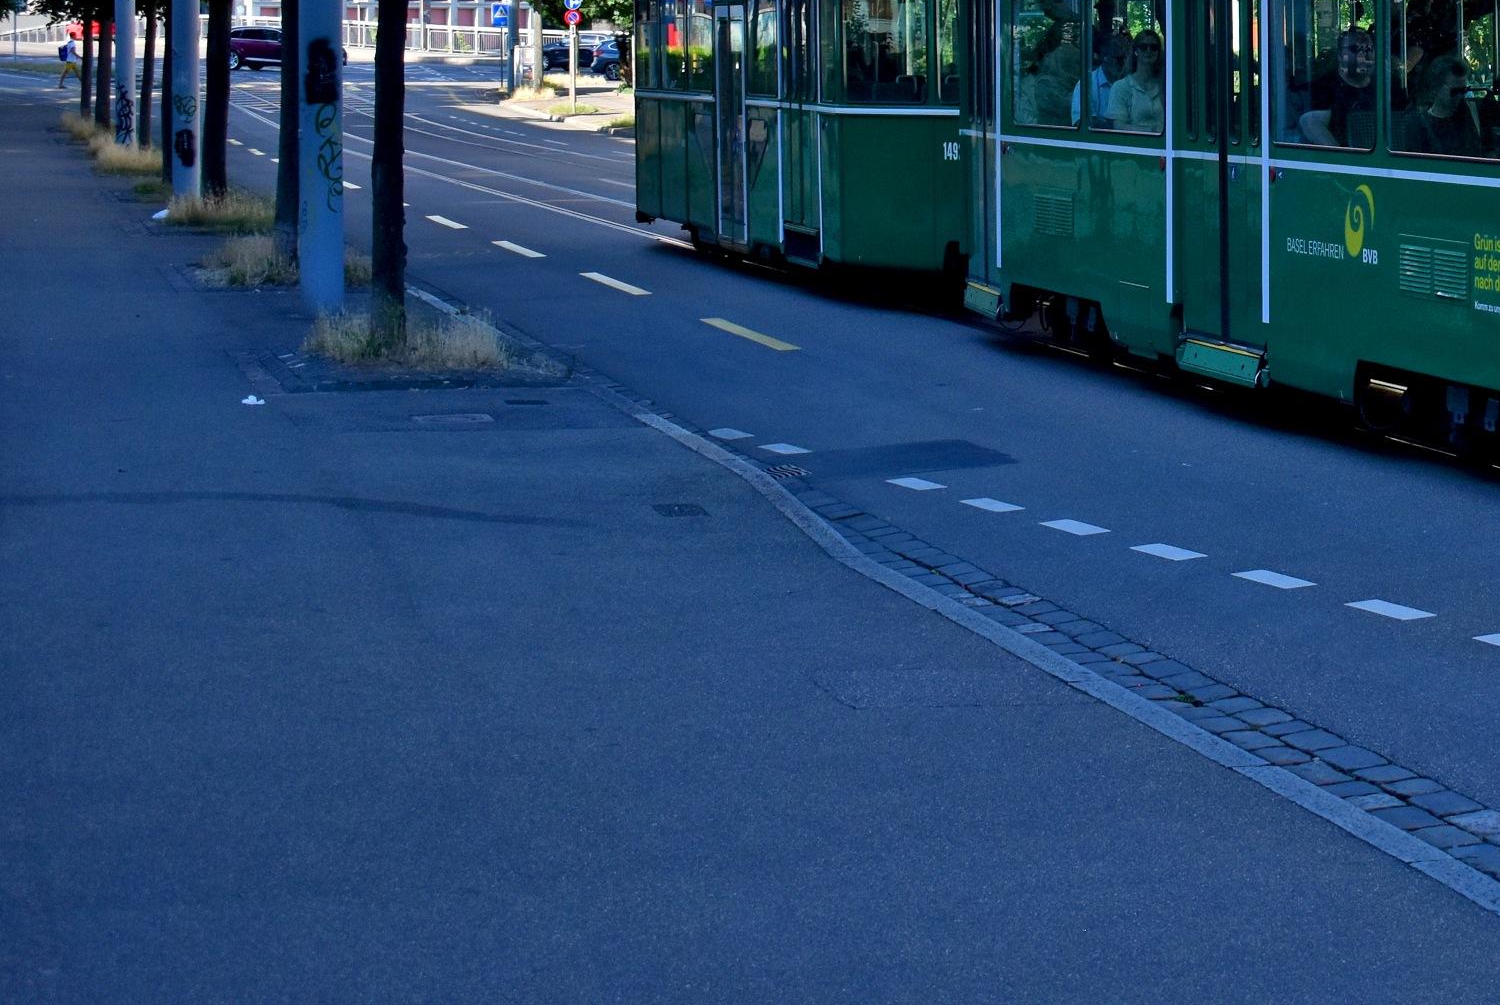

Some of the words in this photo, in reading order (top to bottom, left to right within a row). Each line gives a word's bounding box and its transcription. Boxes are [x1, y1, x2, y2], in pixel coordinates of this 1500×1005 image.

[943, 142, 960, 161] 149
[1286, 237, 1307, 254] BASEL
[1308, 240, 1344, 259] ERFAHREN
[1474, 232, 1494, 252] Grün
[1362, 248, 1378, 265] BVB
[1474, 253, 1487, 270] auf
[1488, 255, 1500, 272] der
[1474, 273, 1494, 290] nach
